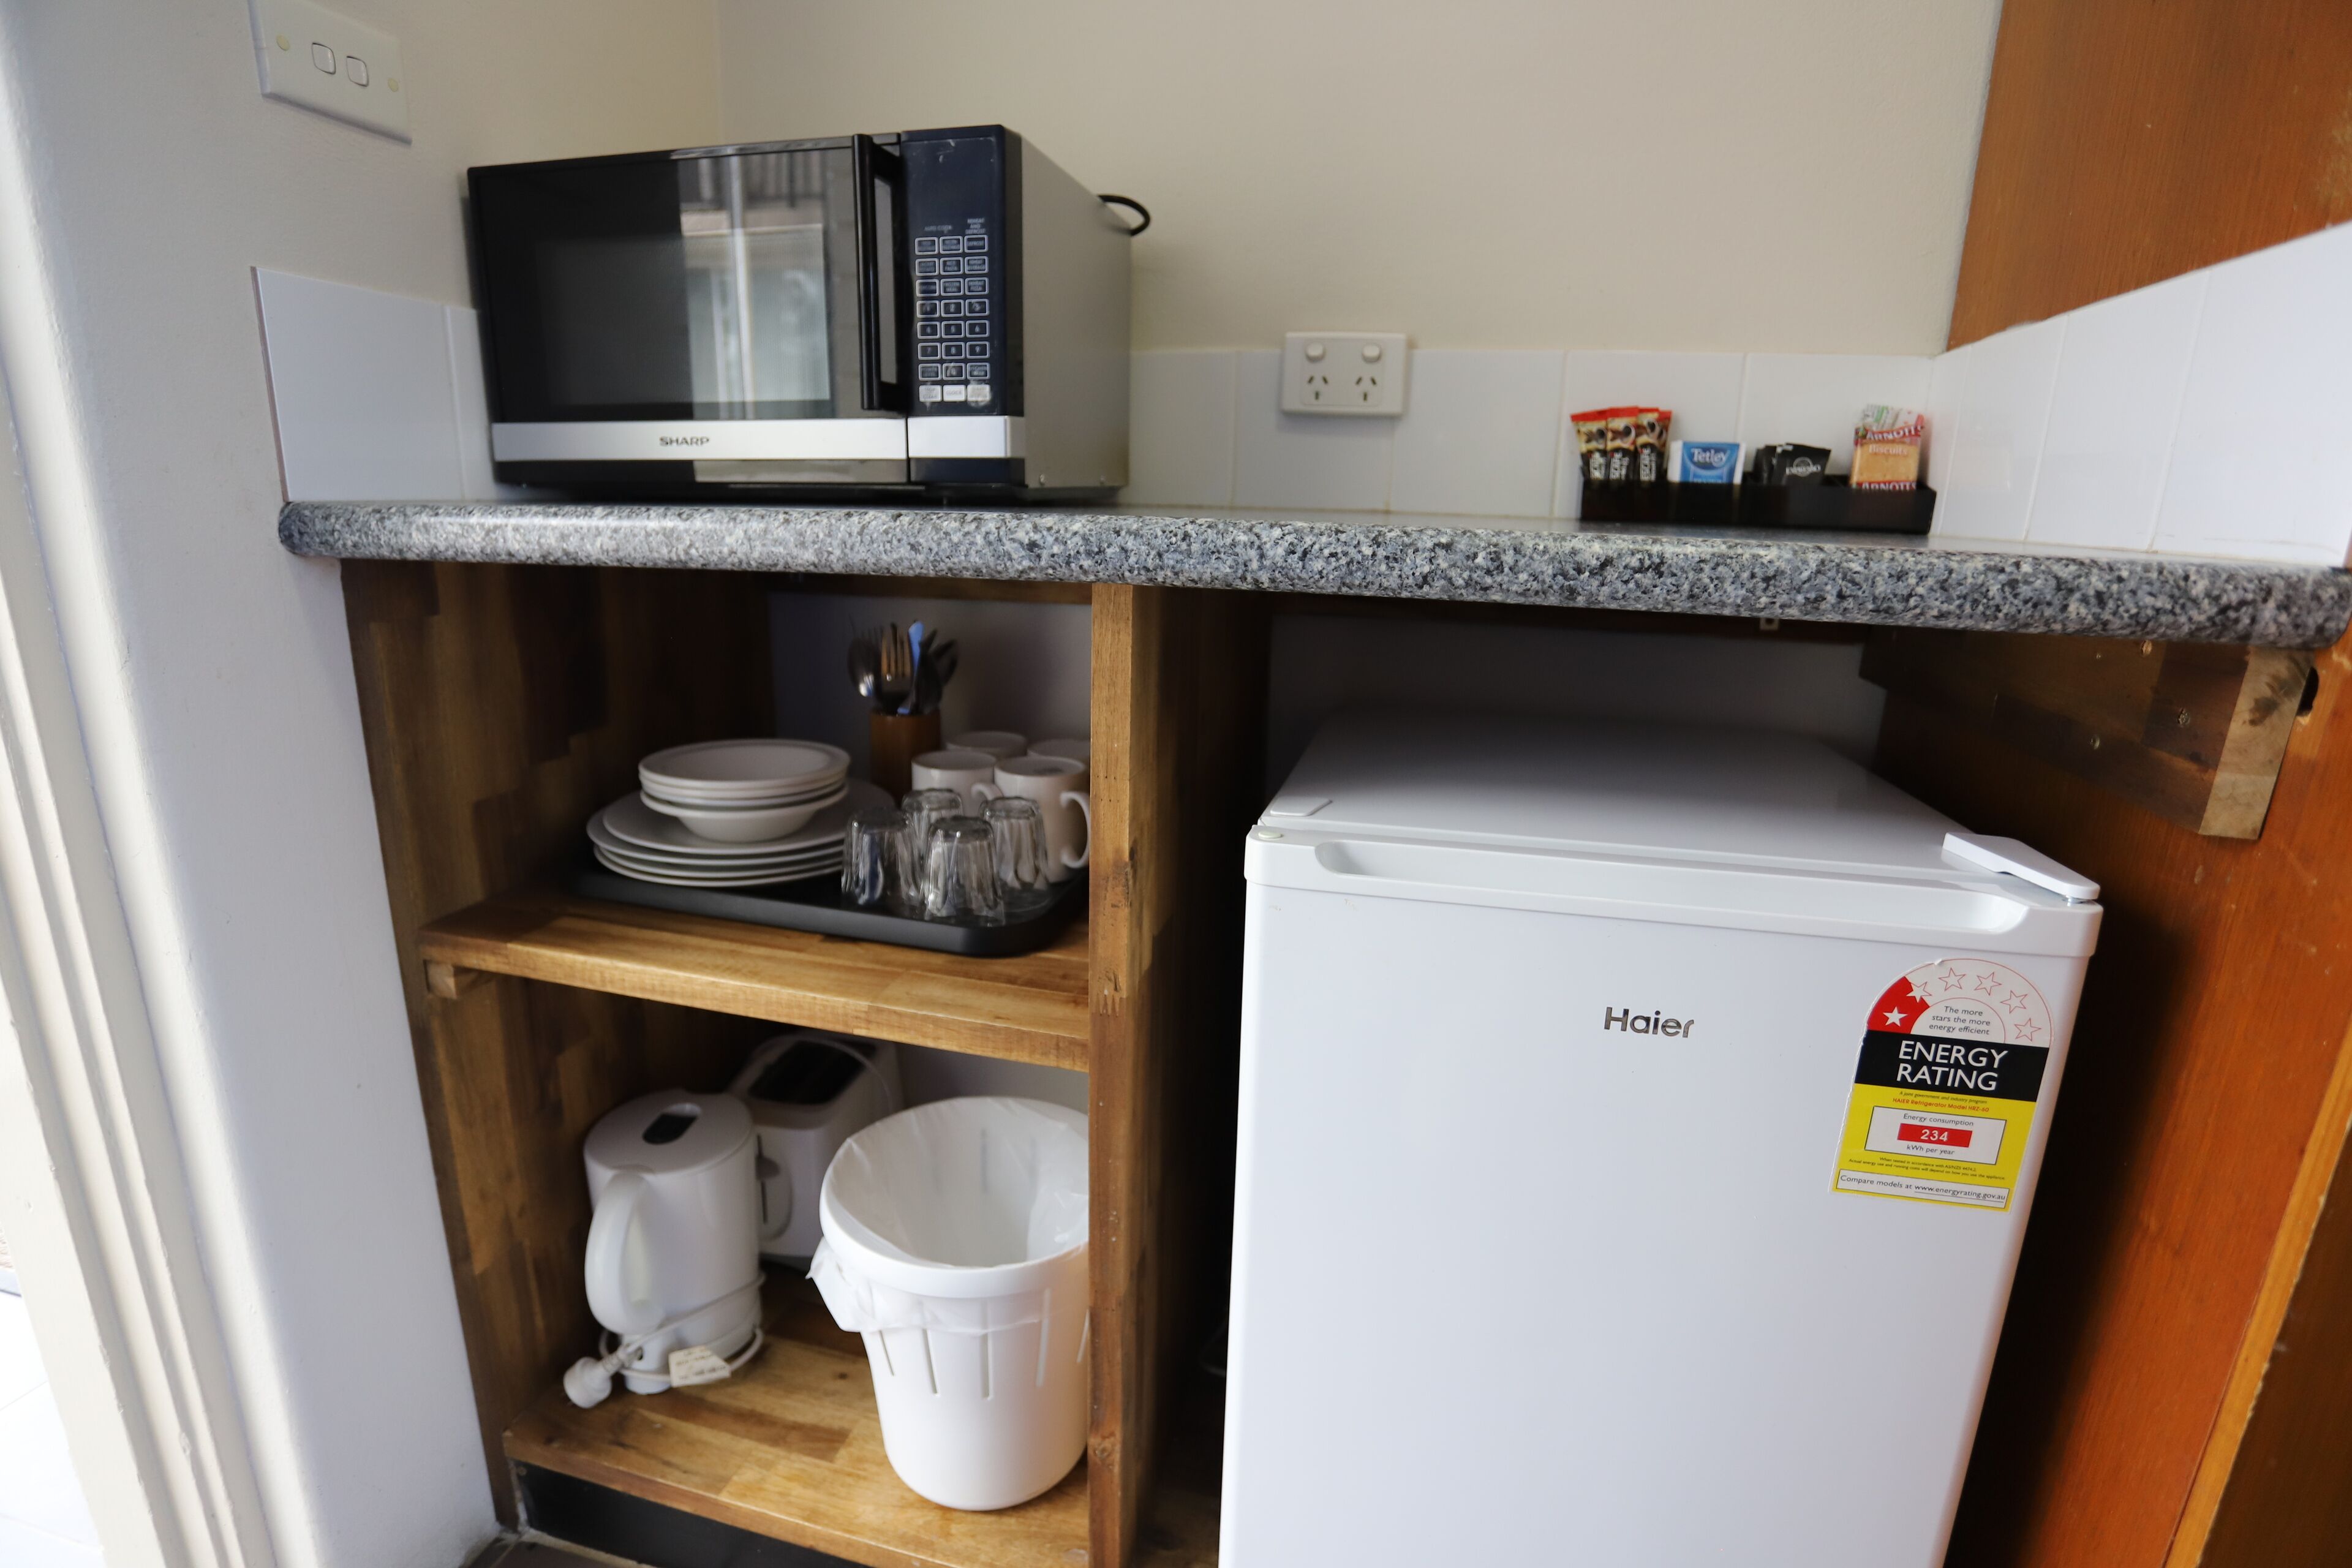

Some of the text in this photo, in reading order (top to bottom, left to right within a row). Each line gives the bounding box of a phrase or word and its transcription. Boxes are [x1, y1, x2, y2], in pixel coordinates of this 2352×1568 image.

[950, 303, 956, 312] 2
[974, 324, 980, 333] 6
[951, 346, 956, 355] 8
[975, 345, 980, 354] 9
[659, 435, 710, 447] SHARP
[1869, 444, 1908, 455] Biscuits
[1691, 448, 1731, 467] Tetley
[1944, 1005, 1959, 1014] The
[1604, 1007, 1694, 1038] Haier
[1954, 1016, 1966, 1024] the
[1929, 1024, 1990, 1035] energy efficient
[1898, 1040, 2008, 1069] ENERGY
[1896, 1063, 1998, 1091] RATING
[1911, 1099, 1947, 1108] Refrigerator
[1903, 1113, 1974, 1126] Energy consumption
[1920, 1129, 1949, 1142] 234
[1840, 1175, 1874, 1185] Compare
[1876, 1180, 1902, 1189] models
[1914, 1186, 2006, 1200] www.energyrating.gov.au
